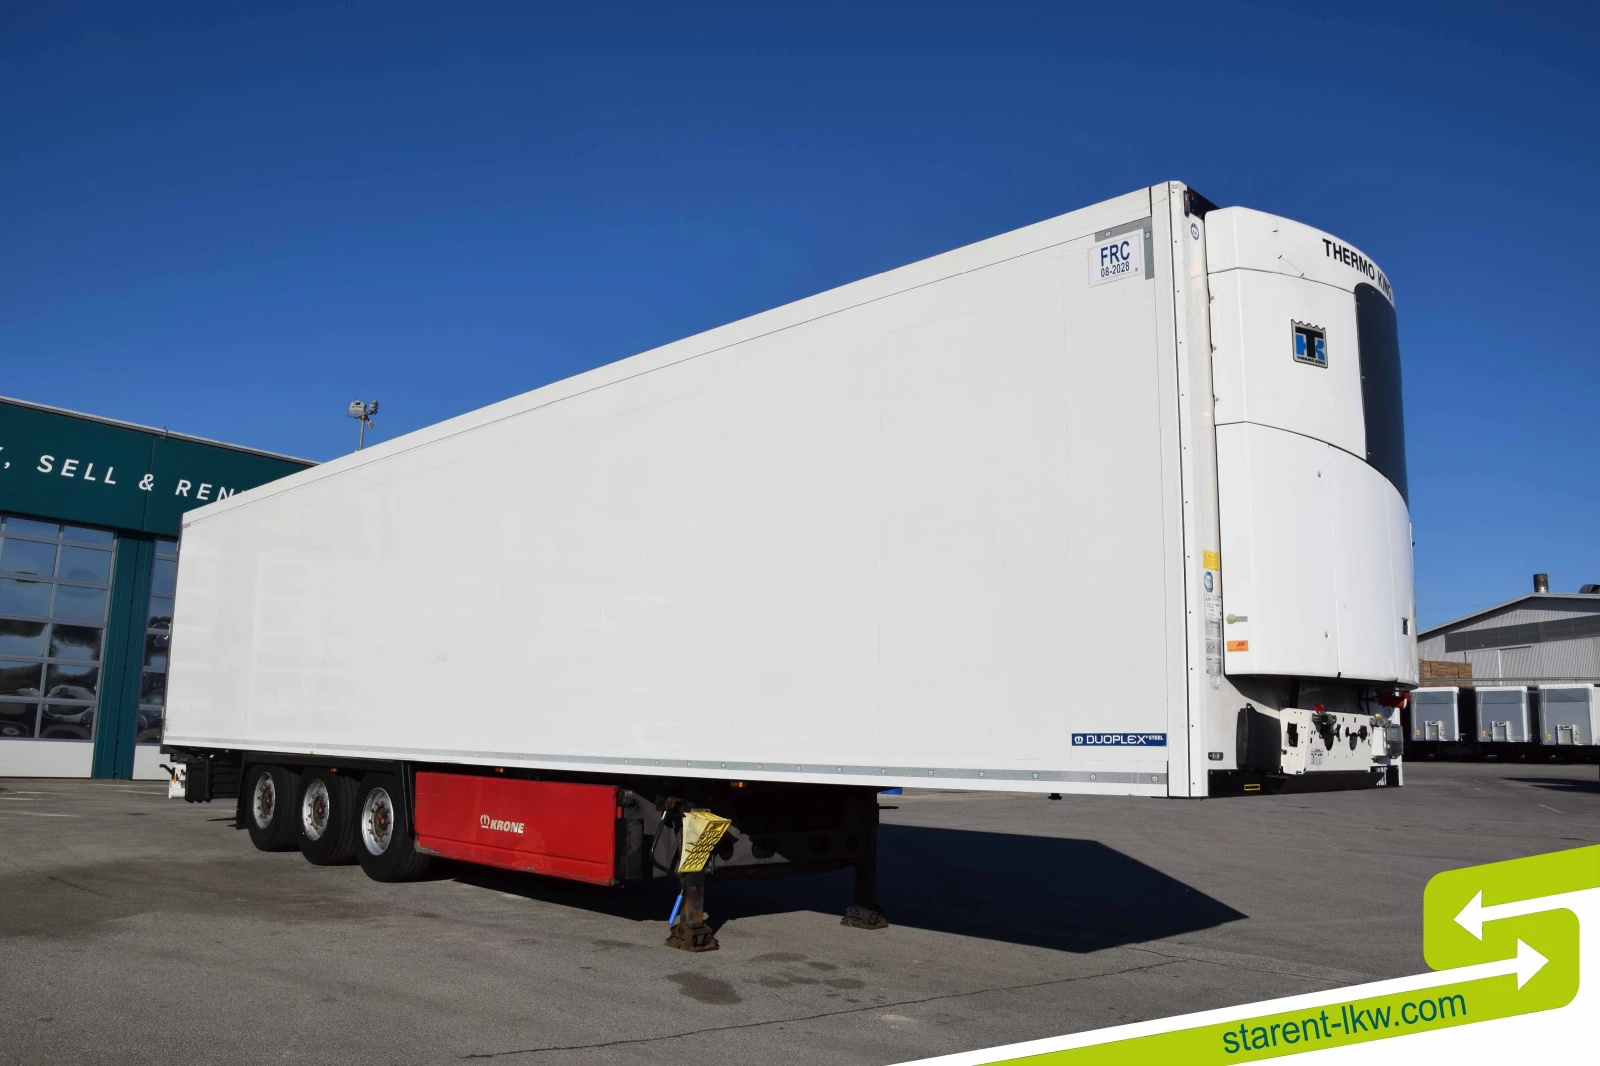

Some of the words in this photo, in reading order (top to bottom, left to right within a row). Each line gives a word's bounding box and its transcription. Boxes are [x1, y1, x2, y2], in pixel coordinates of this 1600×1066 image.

[1100, 240, 1130, 267] FRC
[1322, 237, 1375, 281] THERMO
[1100, 261, 1130, 278] 08-2028
[36, 454, 117, 485] SELL
[138, 473, 155, 491] &
[175, 479, 246, 502] REN
[1086, 734, 1147, 745] DUOPLEX
[490, 819, 525, 834] KRONE
